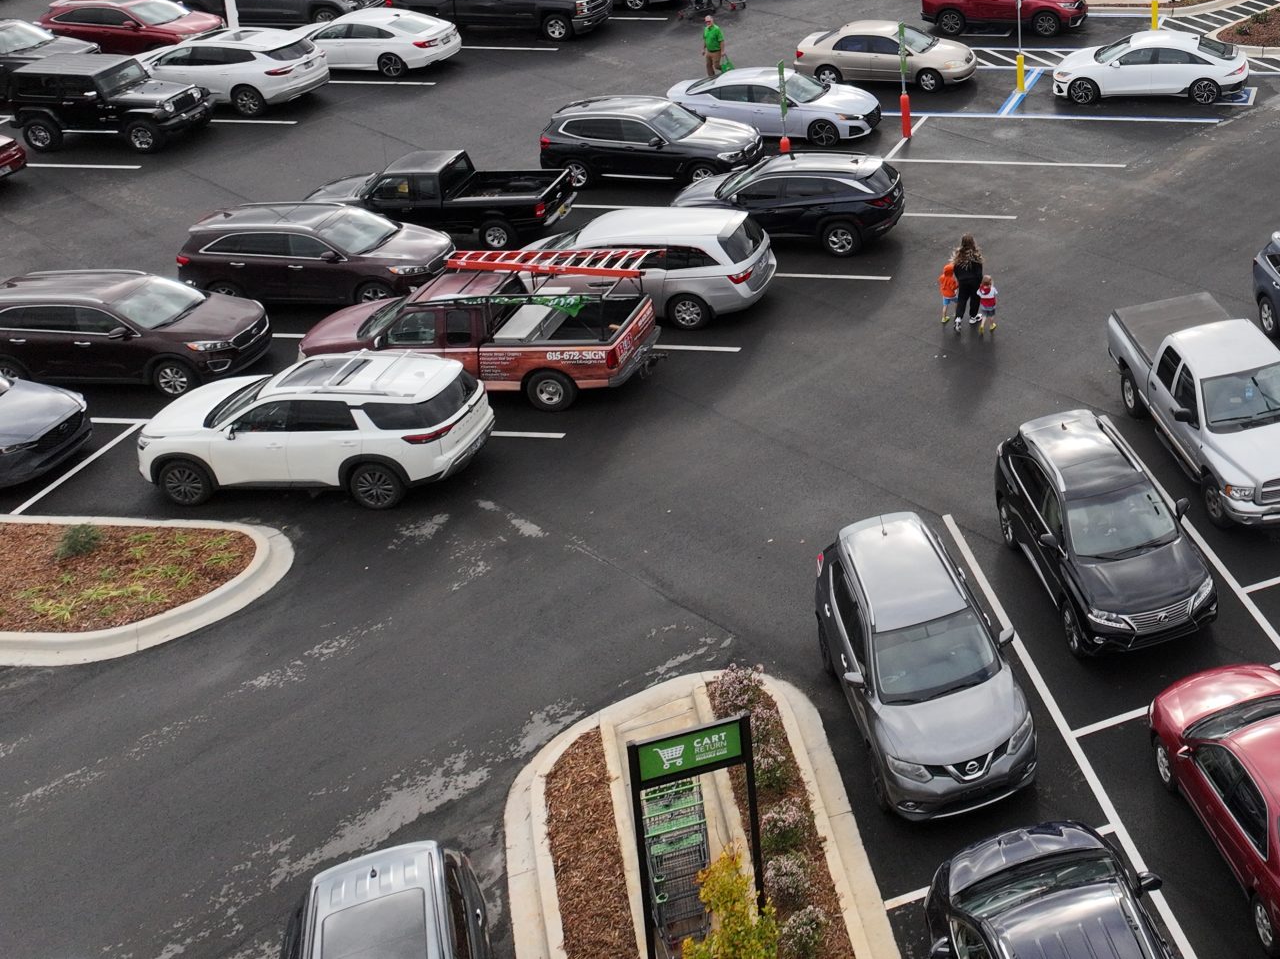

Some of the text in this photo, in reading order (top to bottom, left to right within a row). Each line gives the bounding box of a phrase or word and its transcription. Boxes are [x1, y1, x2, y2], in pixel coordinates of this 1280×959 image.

[547, 351, 606, 360] 615-672-SIGN
[694, 732, 727, 747] CART
[695, 741, 727, 754] RETURN
